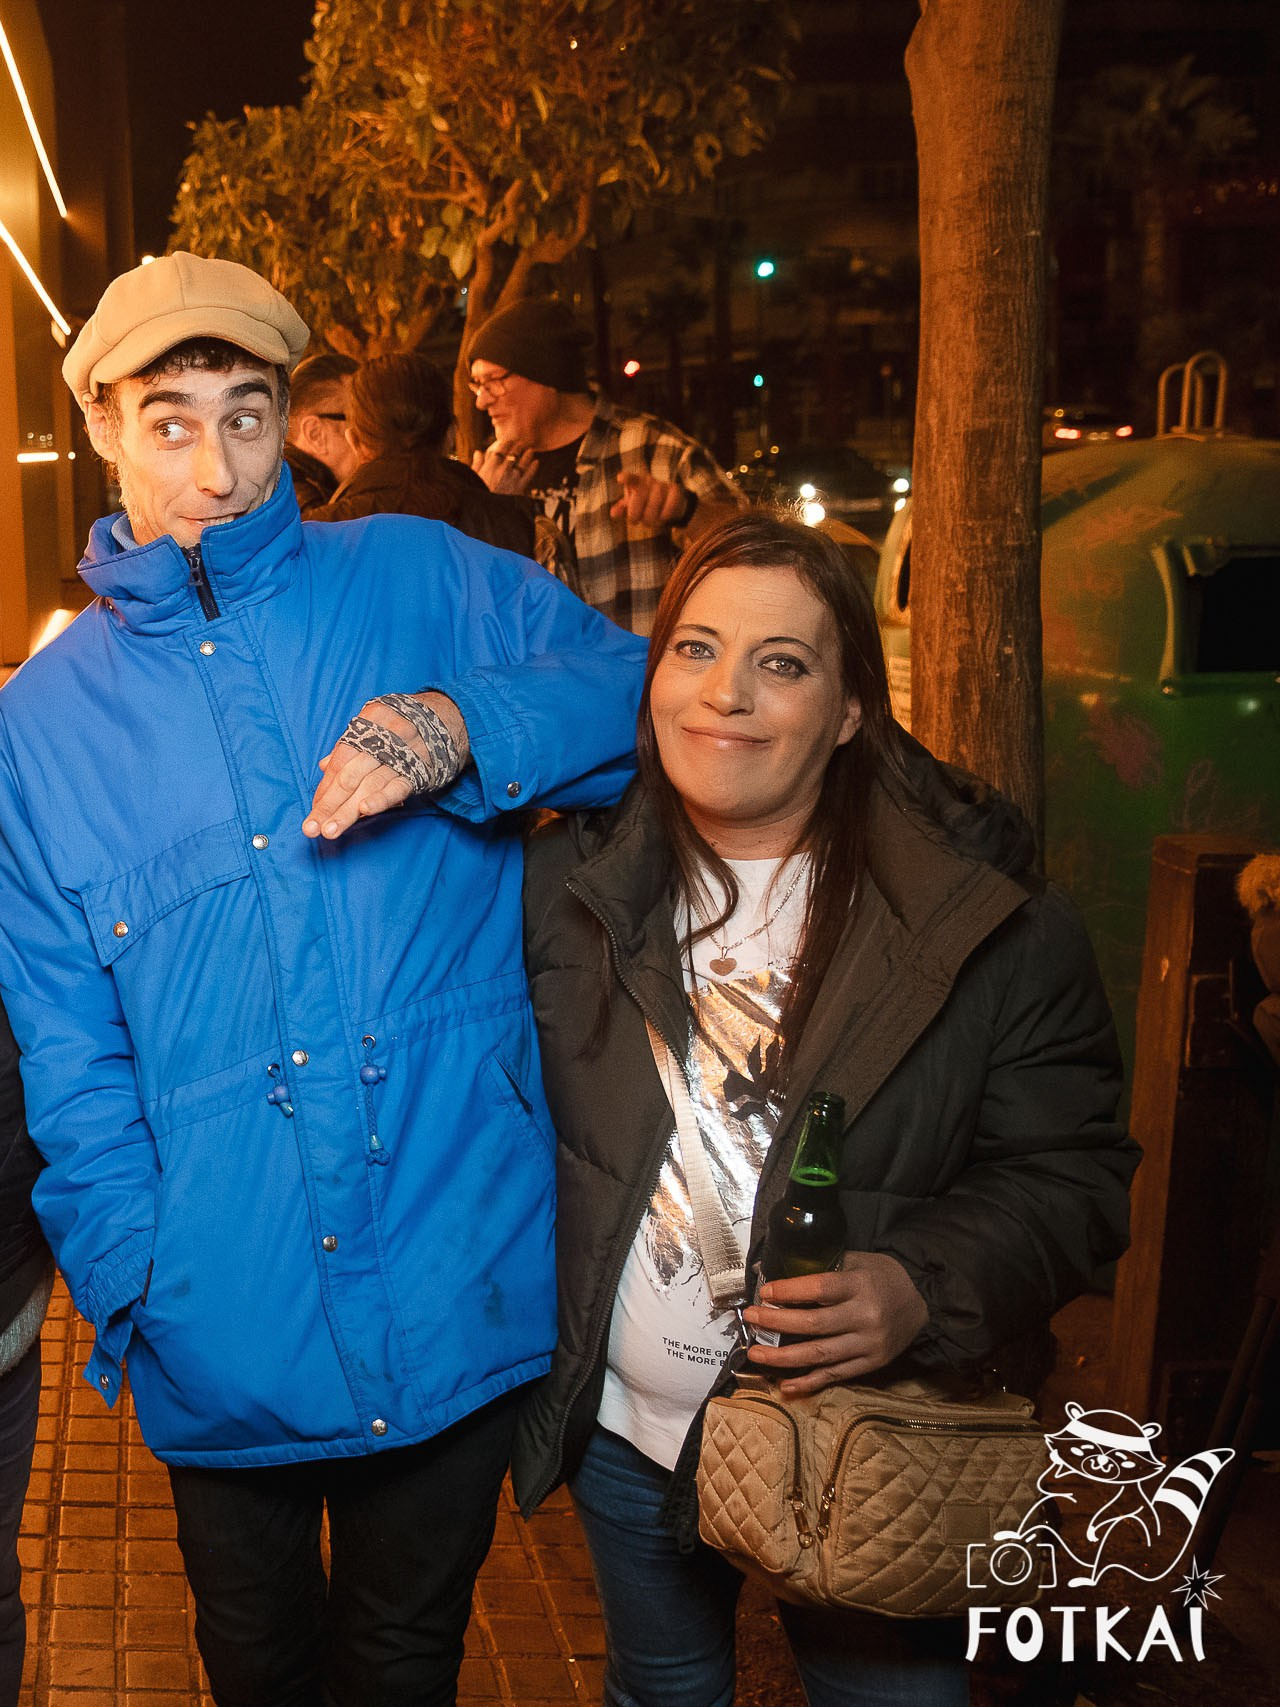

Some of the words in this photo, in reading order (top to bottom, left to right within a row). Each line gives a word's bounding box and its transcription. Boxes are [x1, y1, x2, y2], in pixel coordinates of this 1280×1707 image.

[662, 1336, 681, 1349] THE
[683, 1343, 712, 1356] MORE
[666, 1347, 685, 1360] THE
[687, 1354, 716, 1366] MORE
